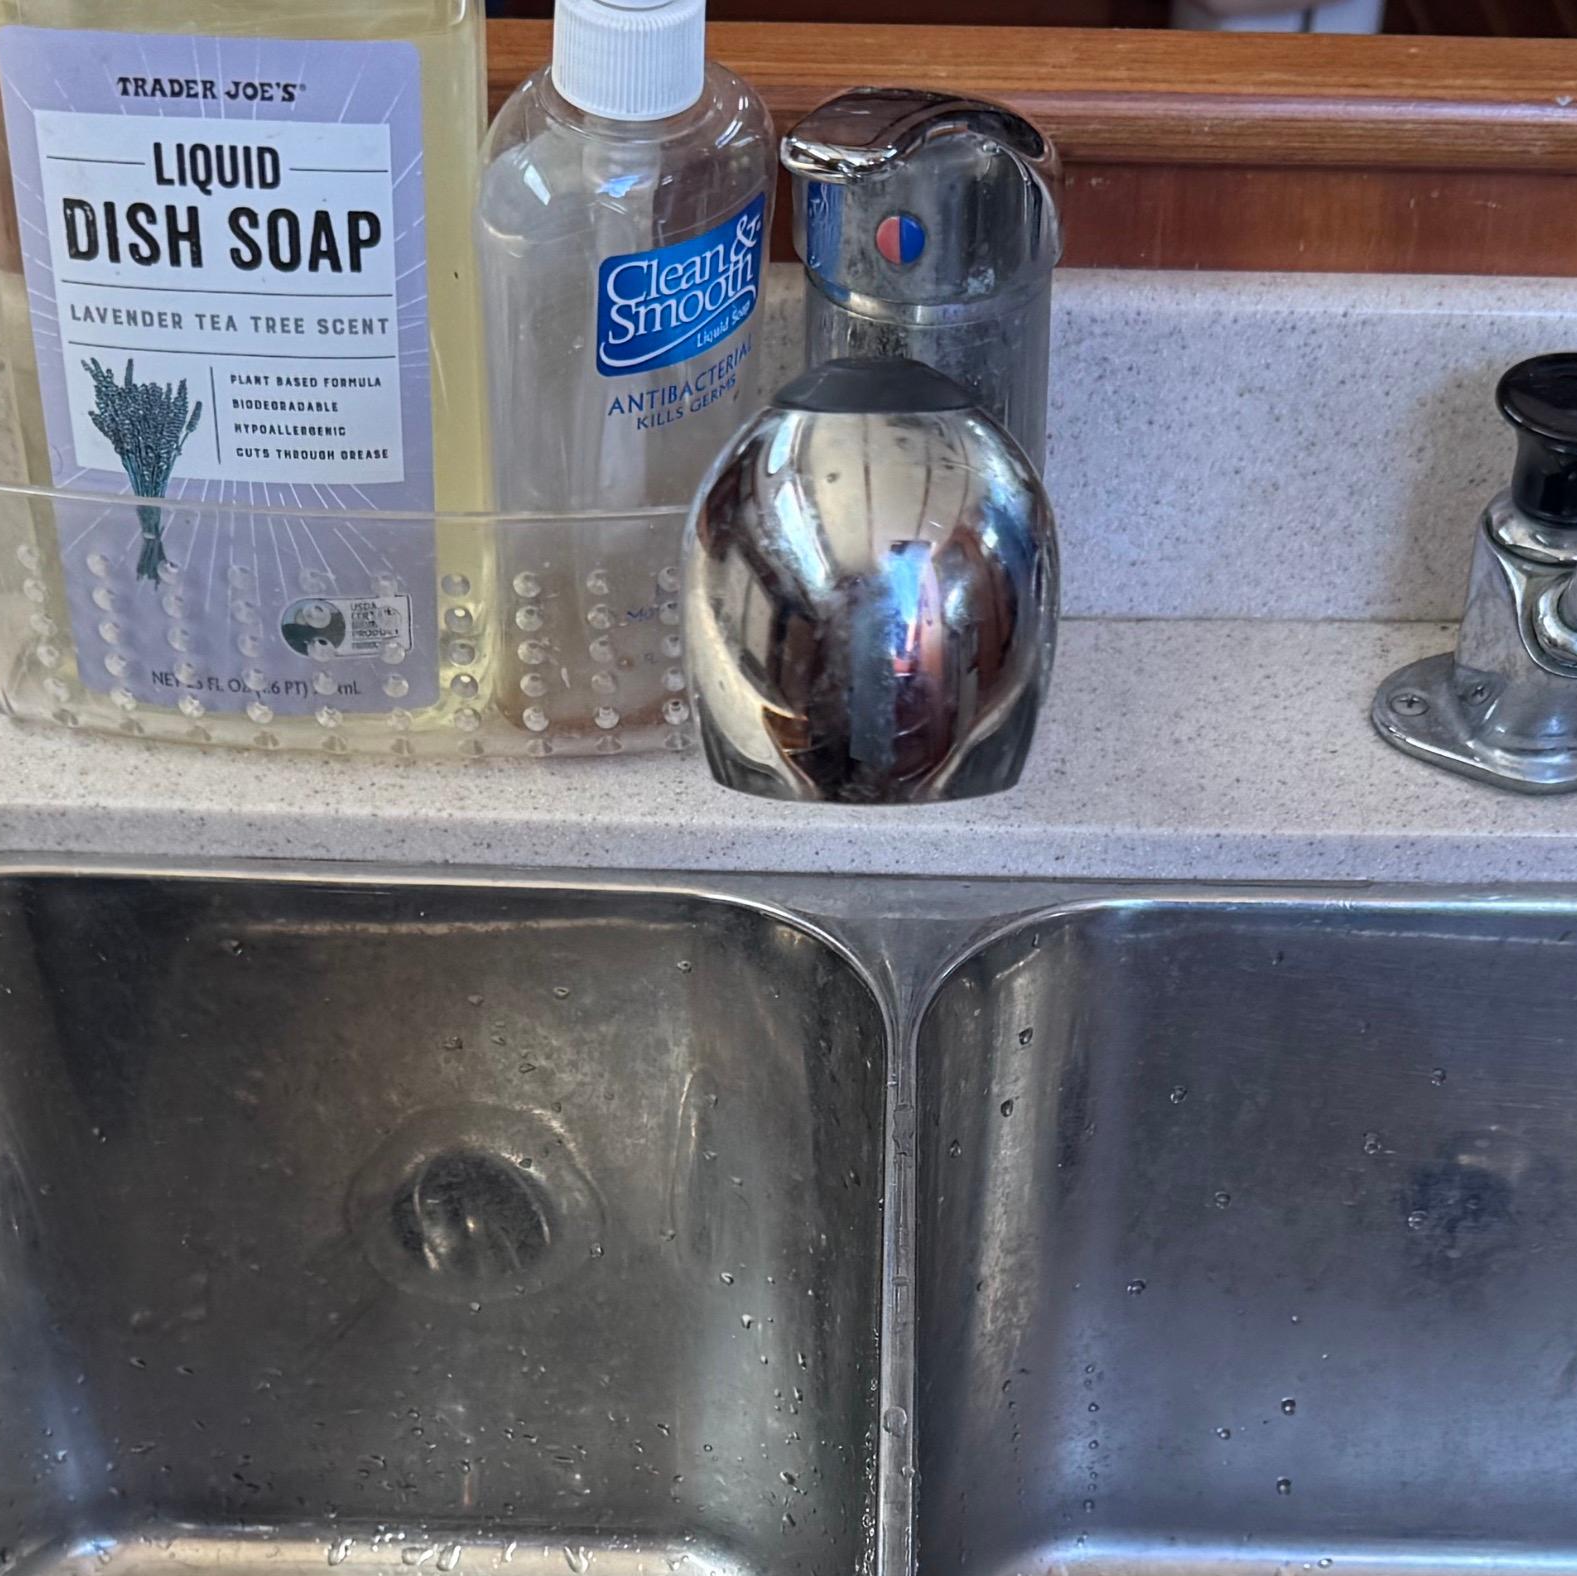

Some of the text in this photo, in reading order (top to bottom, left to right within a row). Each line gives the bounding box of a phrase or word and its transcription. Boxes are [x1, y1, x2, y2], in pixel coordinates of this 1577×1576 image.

[117, 77, 297, 102] TRADER JOE'S
[153, 142, 281, 195] LIQUID
[63, 198, 381, 273] DISH SOAP
[607, 213, 760, 305] Clean &
[70, 304, 390, 336] LAVENDER TEA TREE SCENT
[608, 252, 753, 345] Smooth
[697, 299, 751, 348] Liquid Soap
[230, 374, 382, 388] PLANT BASED FORMULA
[608, 332, 752, 416] ANTIBACTERIAL
[232, 398, 338, 412] BIODEGRADABLE
[636, 375, 736, 430] KILLS GERMS
[234, 422, 346, 437] HYPOALLERGENIC
[236, 447, 389, 461] CUTS THROUGH GREASE
